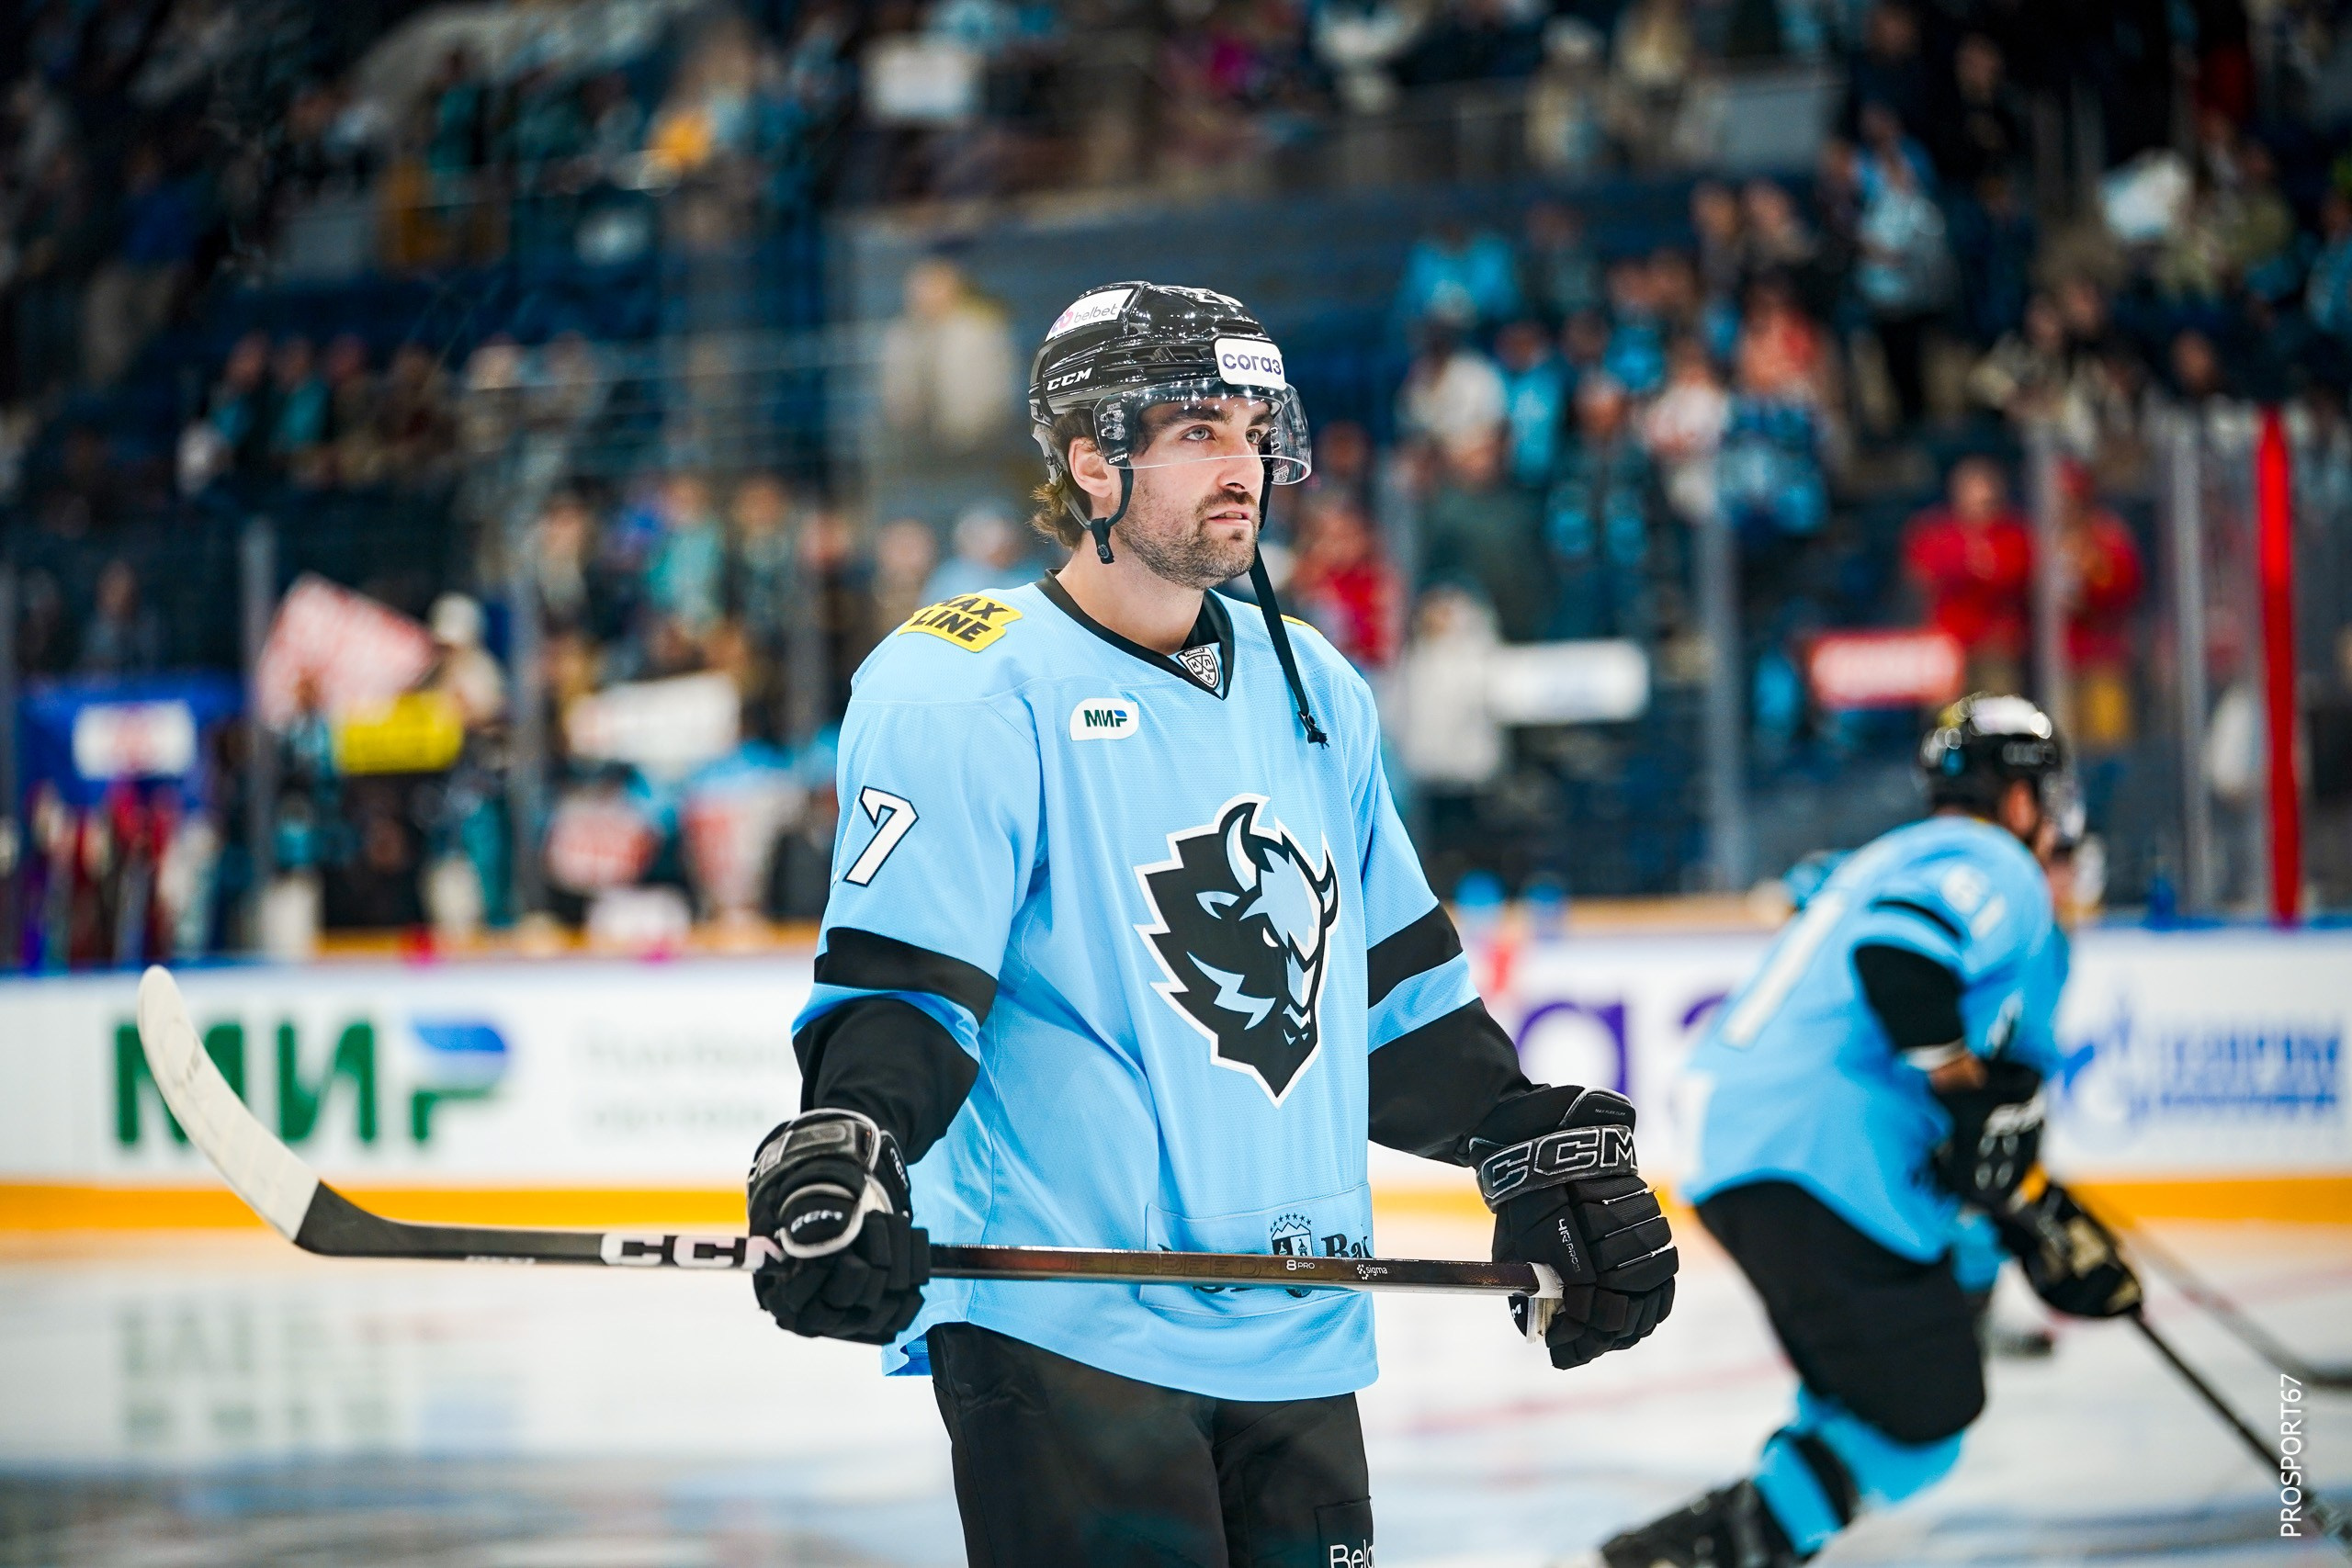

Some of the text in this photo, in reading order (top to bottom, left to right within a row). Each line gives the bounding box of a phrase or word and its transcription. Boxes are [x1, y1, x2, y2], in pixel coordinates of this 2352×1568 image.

[1073, 303, 1118, 323] belbet
[1221, 352, 1283, 377] согаз
[1047, 367, 1093, 391] CCM
[1108, 453, 1128, 465] CCM
[910, 609, 992, 643] LINE
[1083, 709, 1128, 728] МИР
[842, 784, 920, 888] 7
[1480, 1127, 1639, 1200] CCM
[1297, 1261, 1316, 1269] PRO
[1365, 1264, 1388, 1277] sigma
